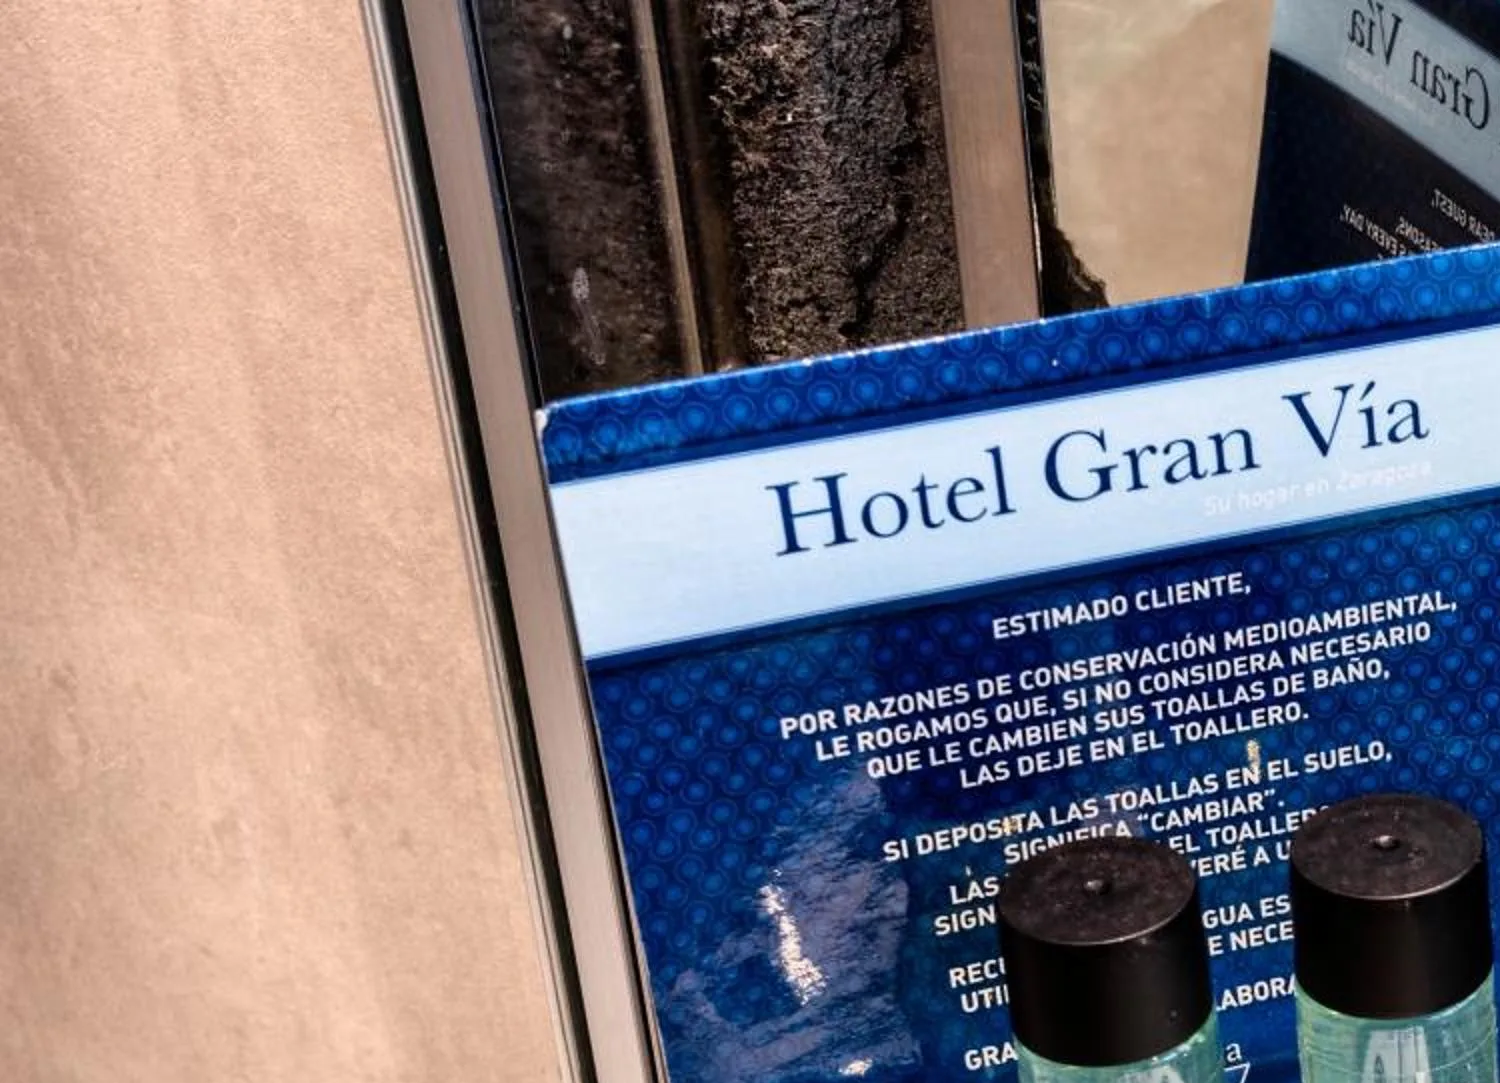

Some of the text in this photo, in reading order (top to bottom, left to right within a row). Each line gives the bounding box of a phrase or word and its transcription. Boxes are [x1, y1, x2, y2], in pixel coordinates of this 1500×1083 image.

[765, 380, 1430, 558] Hotel Gran Vía
[1204, 461, 1433, 517] Su hogar en Zaragoza
[992, 572, 1252, 640] ESTIMADO CLIENTE,
[780, 591, 1457, 740] POR RAZONES DE CONSERVACIÓN MEDIOAMBIENTAL,
[815, 622, 1431, 761] LE ROGAMOS QUE, SI NO CONSIDERA NECESARIO
[867, 657, 1390, 779] QUE LE CAMBIEN SUS TOALLAS DE BAÑO,
[960, 702, 1309, 789] LAS DEJE EN EL TOALLERO.
[883, 741, 1392, 862] SI DEPOSITA LAS TOALLAS EN EL SUELO,
[934, 904, 998, 936] SIGN
[1202, 902, 1255, 929] GUA
[1229, 920, 1295, 951] NECE
[964, 1041, 1020, 1071] GRA
